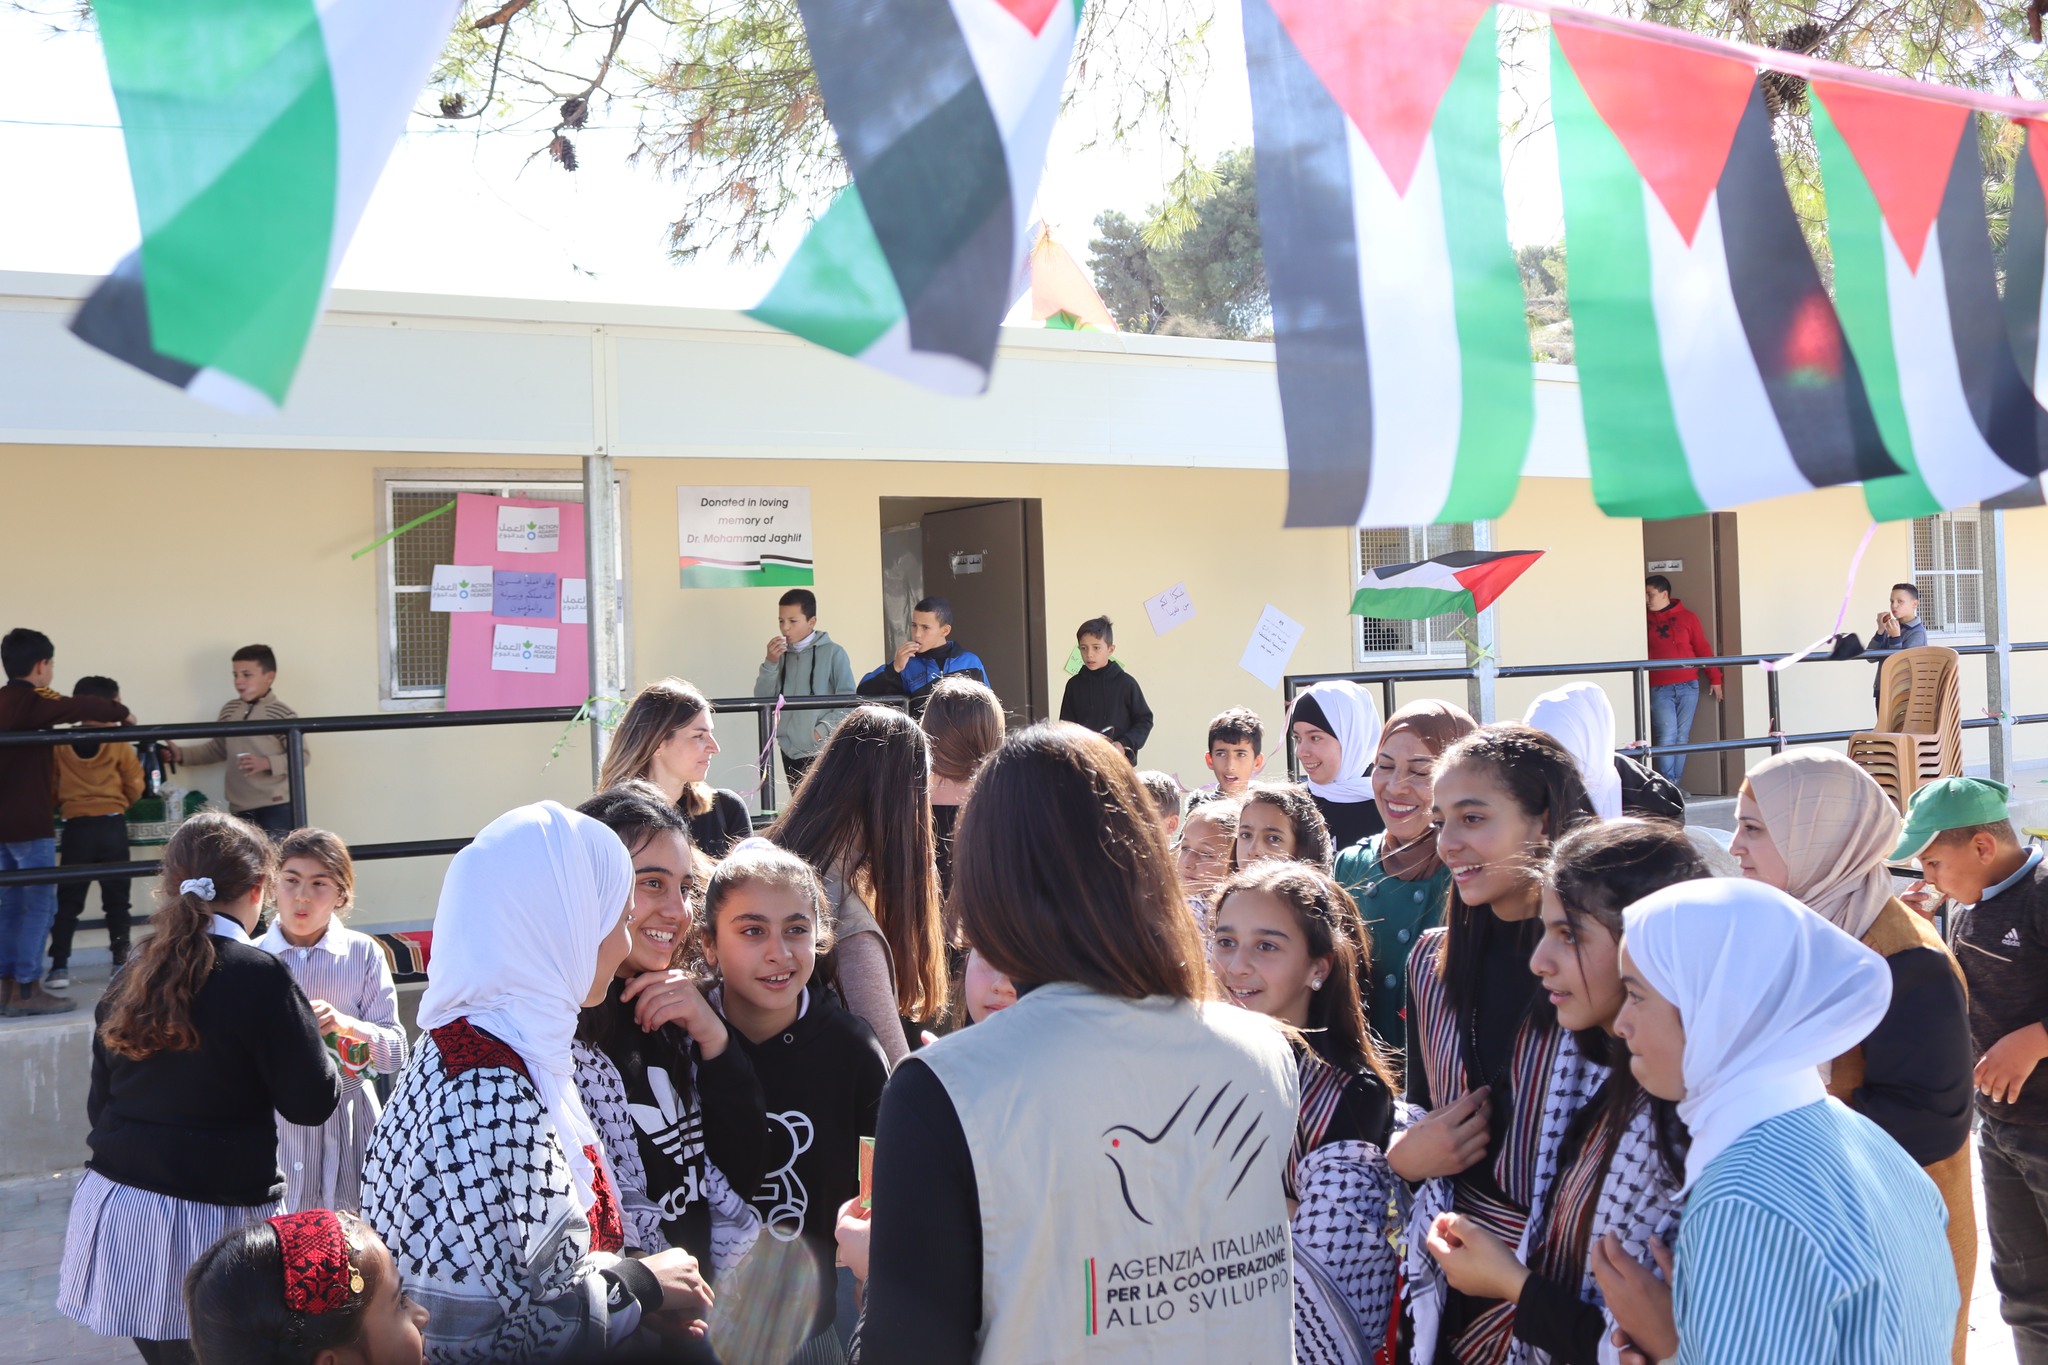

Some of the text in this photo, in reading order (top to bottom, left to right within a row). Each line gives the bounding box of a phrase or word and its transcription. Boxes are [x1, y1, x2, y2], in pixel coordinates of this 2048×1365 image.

[700, 498, 789, 509] Donated in loving
[718, 516, 774, 526] memory of
[687, 534, 700, 543] Dr.
[704, 533, 766, 543] Mohammad
[1108, 1224, 1286, 1283] AGENZIA ITALIANA
[1107, 1248, 1286, 1304] PER LA COOPERAZIONE
[1106, 1268, 1289, 1329] ALLO SVILUPPO
